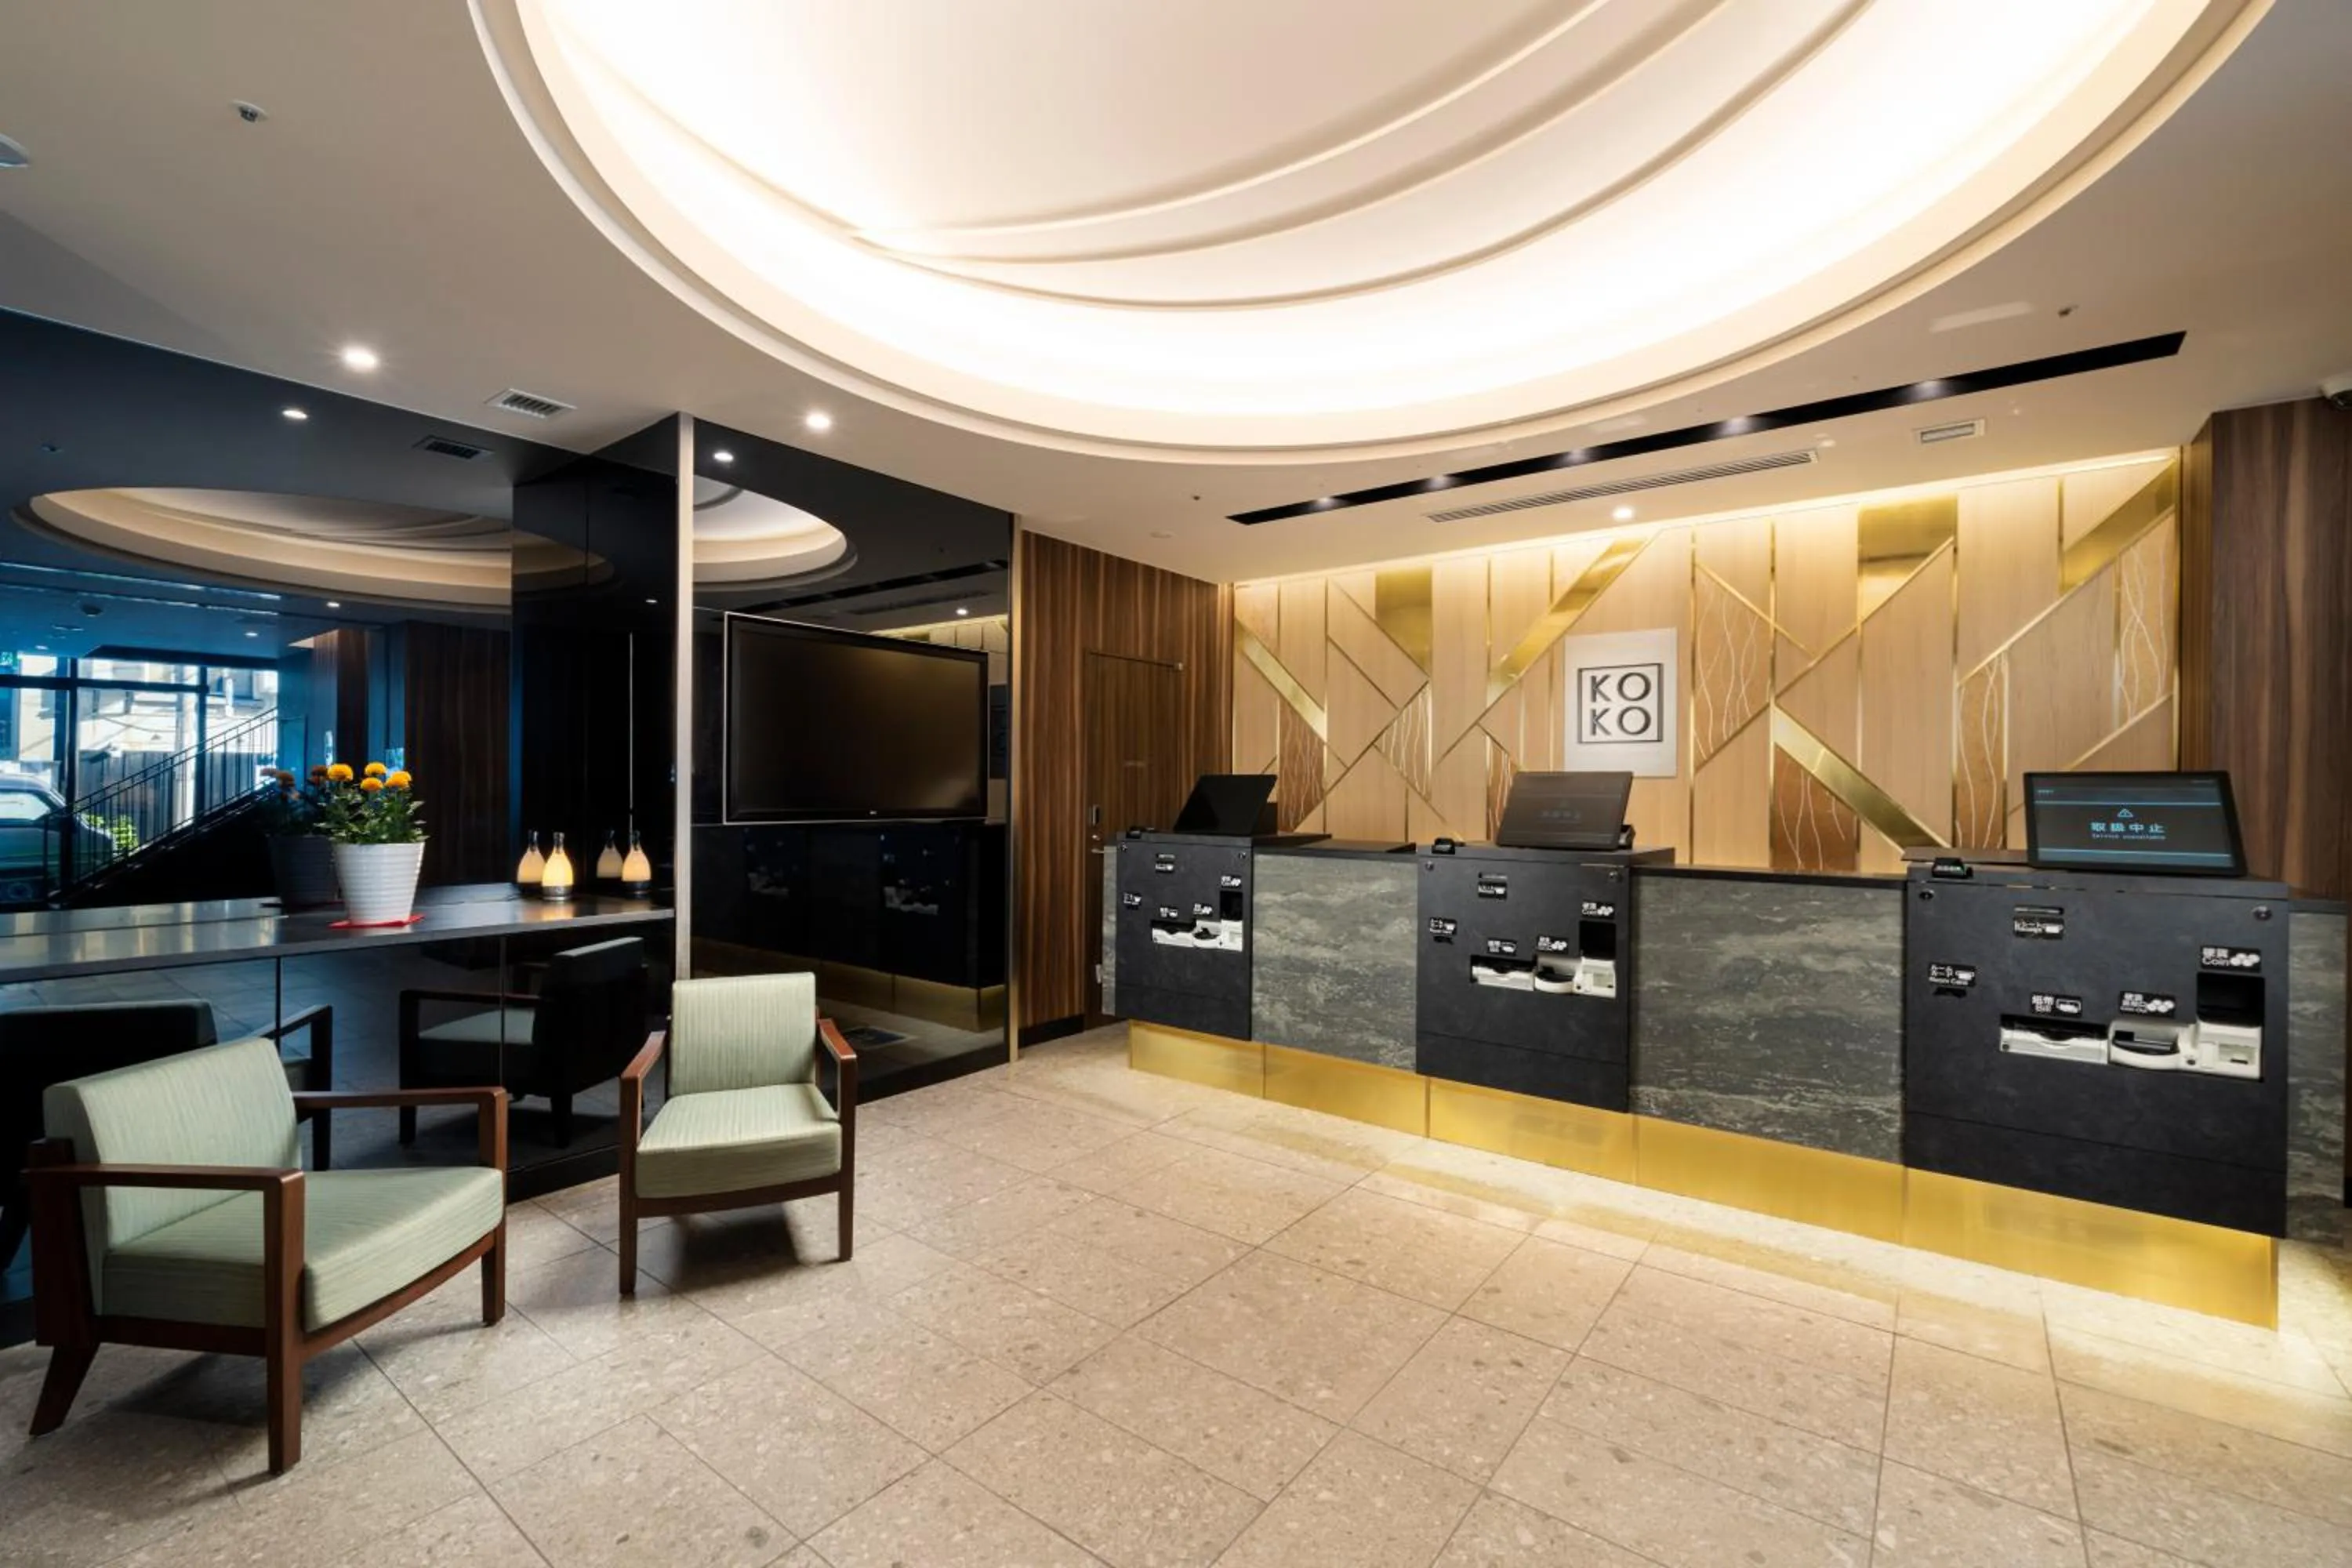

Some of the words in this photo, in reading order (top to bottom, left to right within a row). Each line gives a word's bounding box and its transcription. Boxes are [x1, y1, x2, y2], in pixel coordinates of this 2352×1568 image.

[1590, 672, 1652, 702] KO
[1590, 706, 1652, 735] KO
[2201, 956, 2230, 967] Coin
